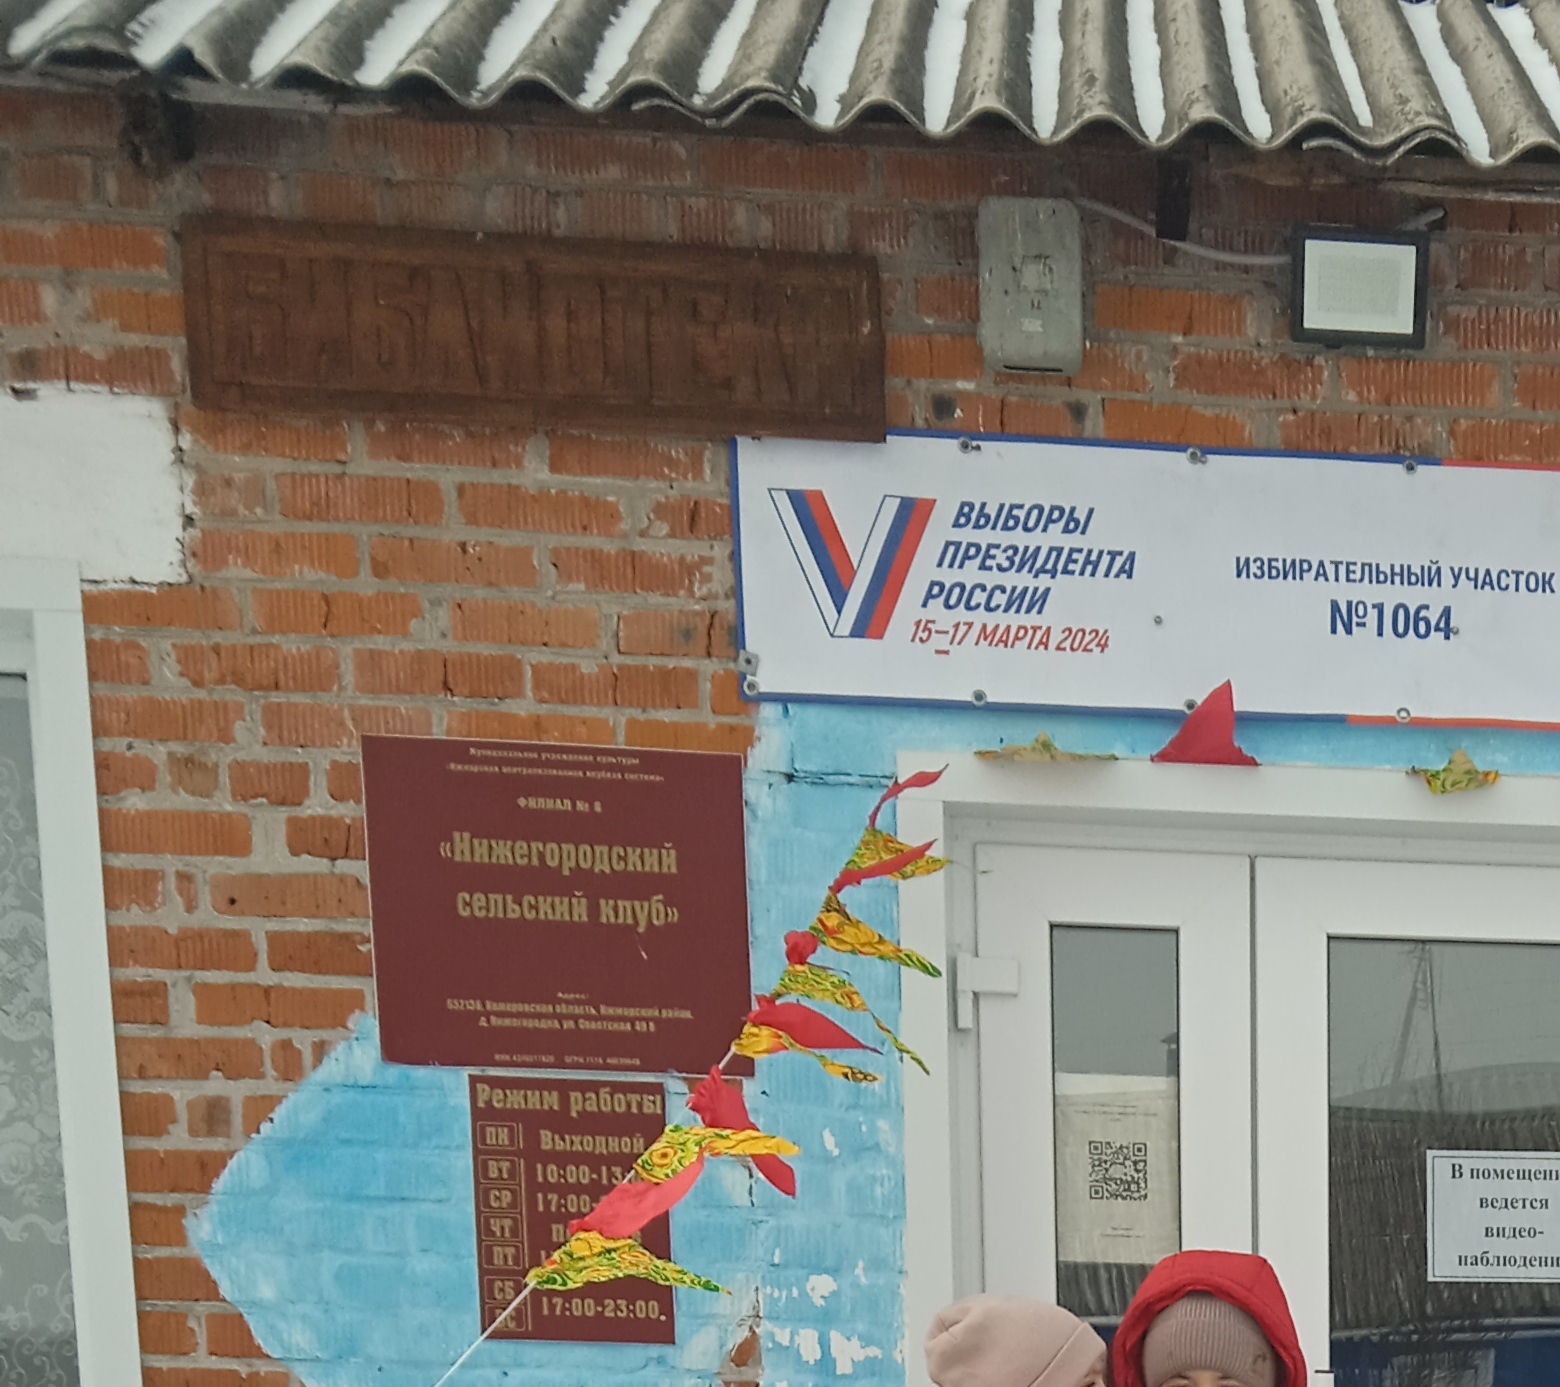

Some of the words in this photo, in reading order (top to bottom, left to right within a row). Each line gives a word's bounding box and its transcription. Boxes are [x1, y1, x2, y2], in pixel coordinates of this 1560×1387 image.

[951, 500, 1095, 535] ВЫБОРЫ
[936, 539, 1136, 580] ПРЕЗИДЕНТА
[1235, 556, 1442, 588] ИЗБИРАТЕЛЬНЫЙ
[1449, 565, 1556, 594] УЧАСТОК
[920, 579, 1052, 615] РОССИИ
[1329, 598, 1452, 641] №1064
[974, 622, 1052, 651] МАРТА
[1055, 626, 1110, 654] 2024
[439, 830, 679, 876] «Нижегородский
[456, 890, 588, 923] сельский
[599, 893, 680, 934] клуб»
[476, 1082, 560, 1111] Режим
[569, 1087, 663, 1119] работы
[485, 1126, 509, 1146] ПН
[539, 1129, 645, 1156] Выходной
[487, 1160, 511, 1179] ВТ
[1450, 1162, 1463, 1180] В
[489, 1190, 511, 1208] СР
[1479, 1196, 1549, 1210] ведется
[490, 1217, 513, 1238] ЧТ
[1484, 1225, 1545, 1239] видео-
[493, 1246, 516, 1266] ПТ
[494, 1280, 515, 1300] СБ
